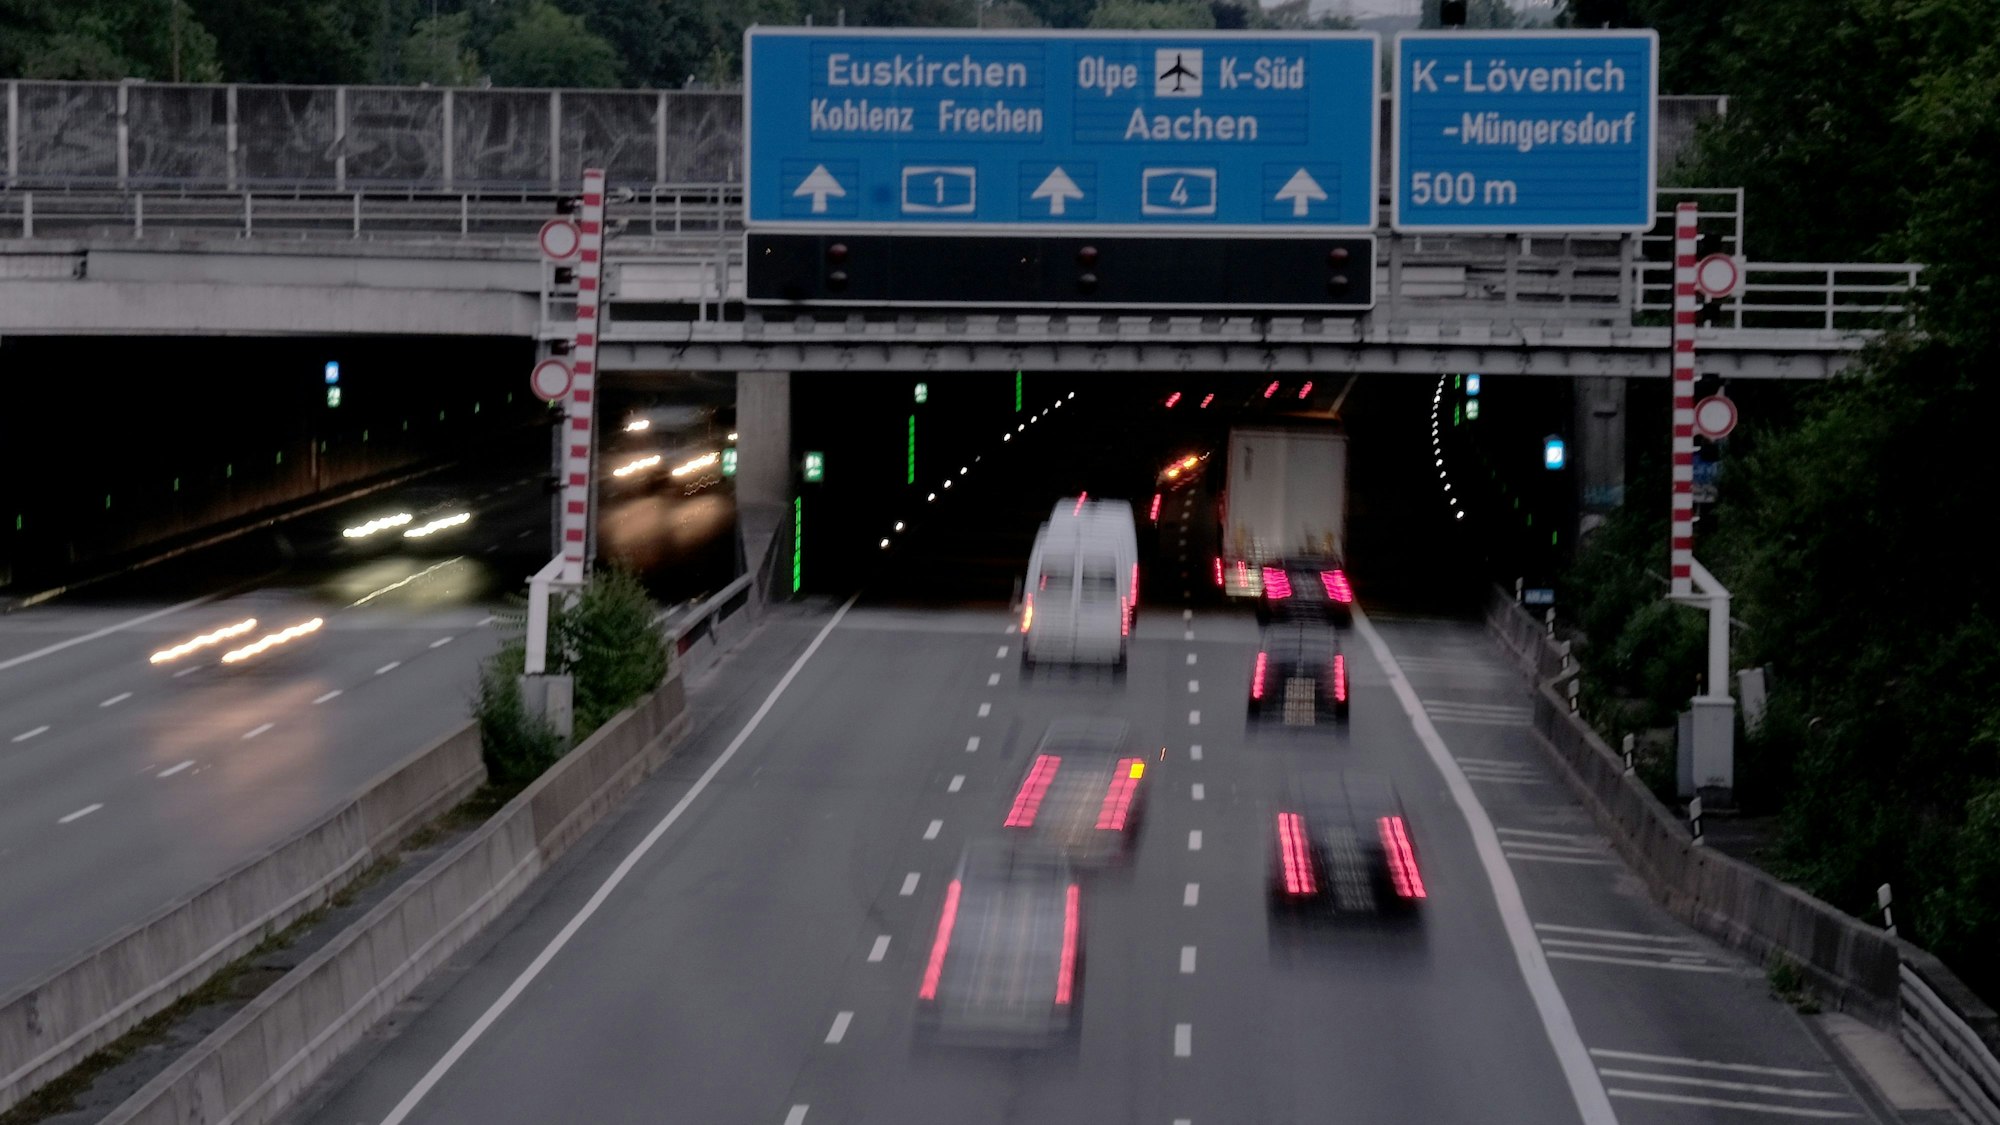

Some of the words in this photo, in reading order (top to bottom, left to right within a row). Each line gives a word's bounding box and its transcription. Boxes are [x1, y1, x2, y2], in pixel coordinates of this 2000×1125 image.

[829, 54, 1026, 86] Euskirchen
[1080, 57, 1136, 96] Olpe
[1221, 58, 1303, 88] K-Süd
[1414, 60, 1624, 91] K-Lövenich
[812, 100, 912, 130] Koblenz
[940, 101, 1042, 132] Frechen
[1126, 108, 1256, 139] Aachen
[1444, 113, 1634, 151] -Müngersdorf
[933, 176, 945, 203] 1
[1170, 178, 1189, 205] 4
[1413, 173, 1474, 204] 500
[1485, 181, 1516, 203] m
